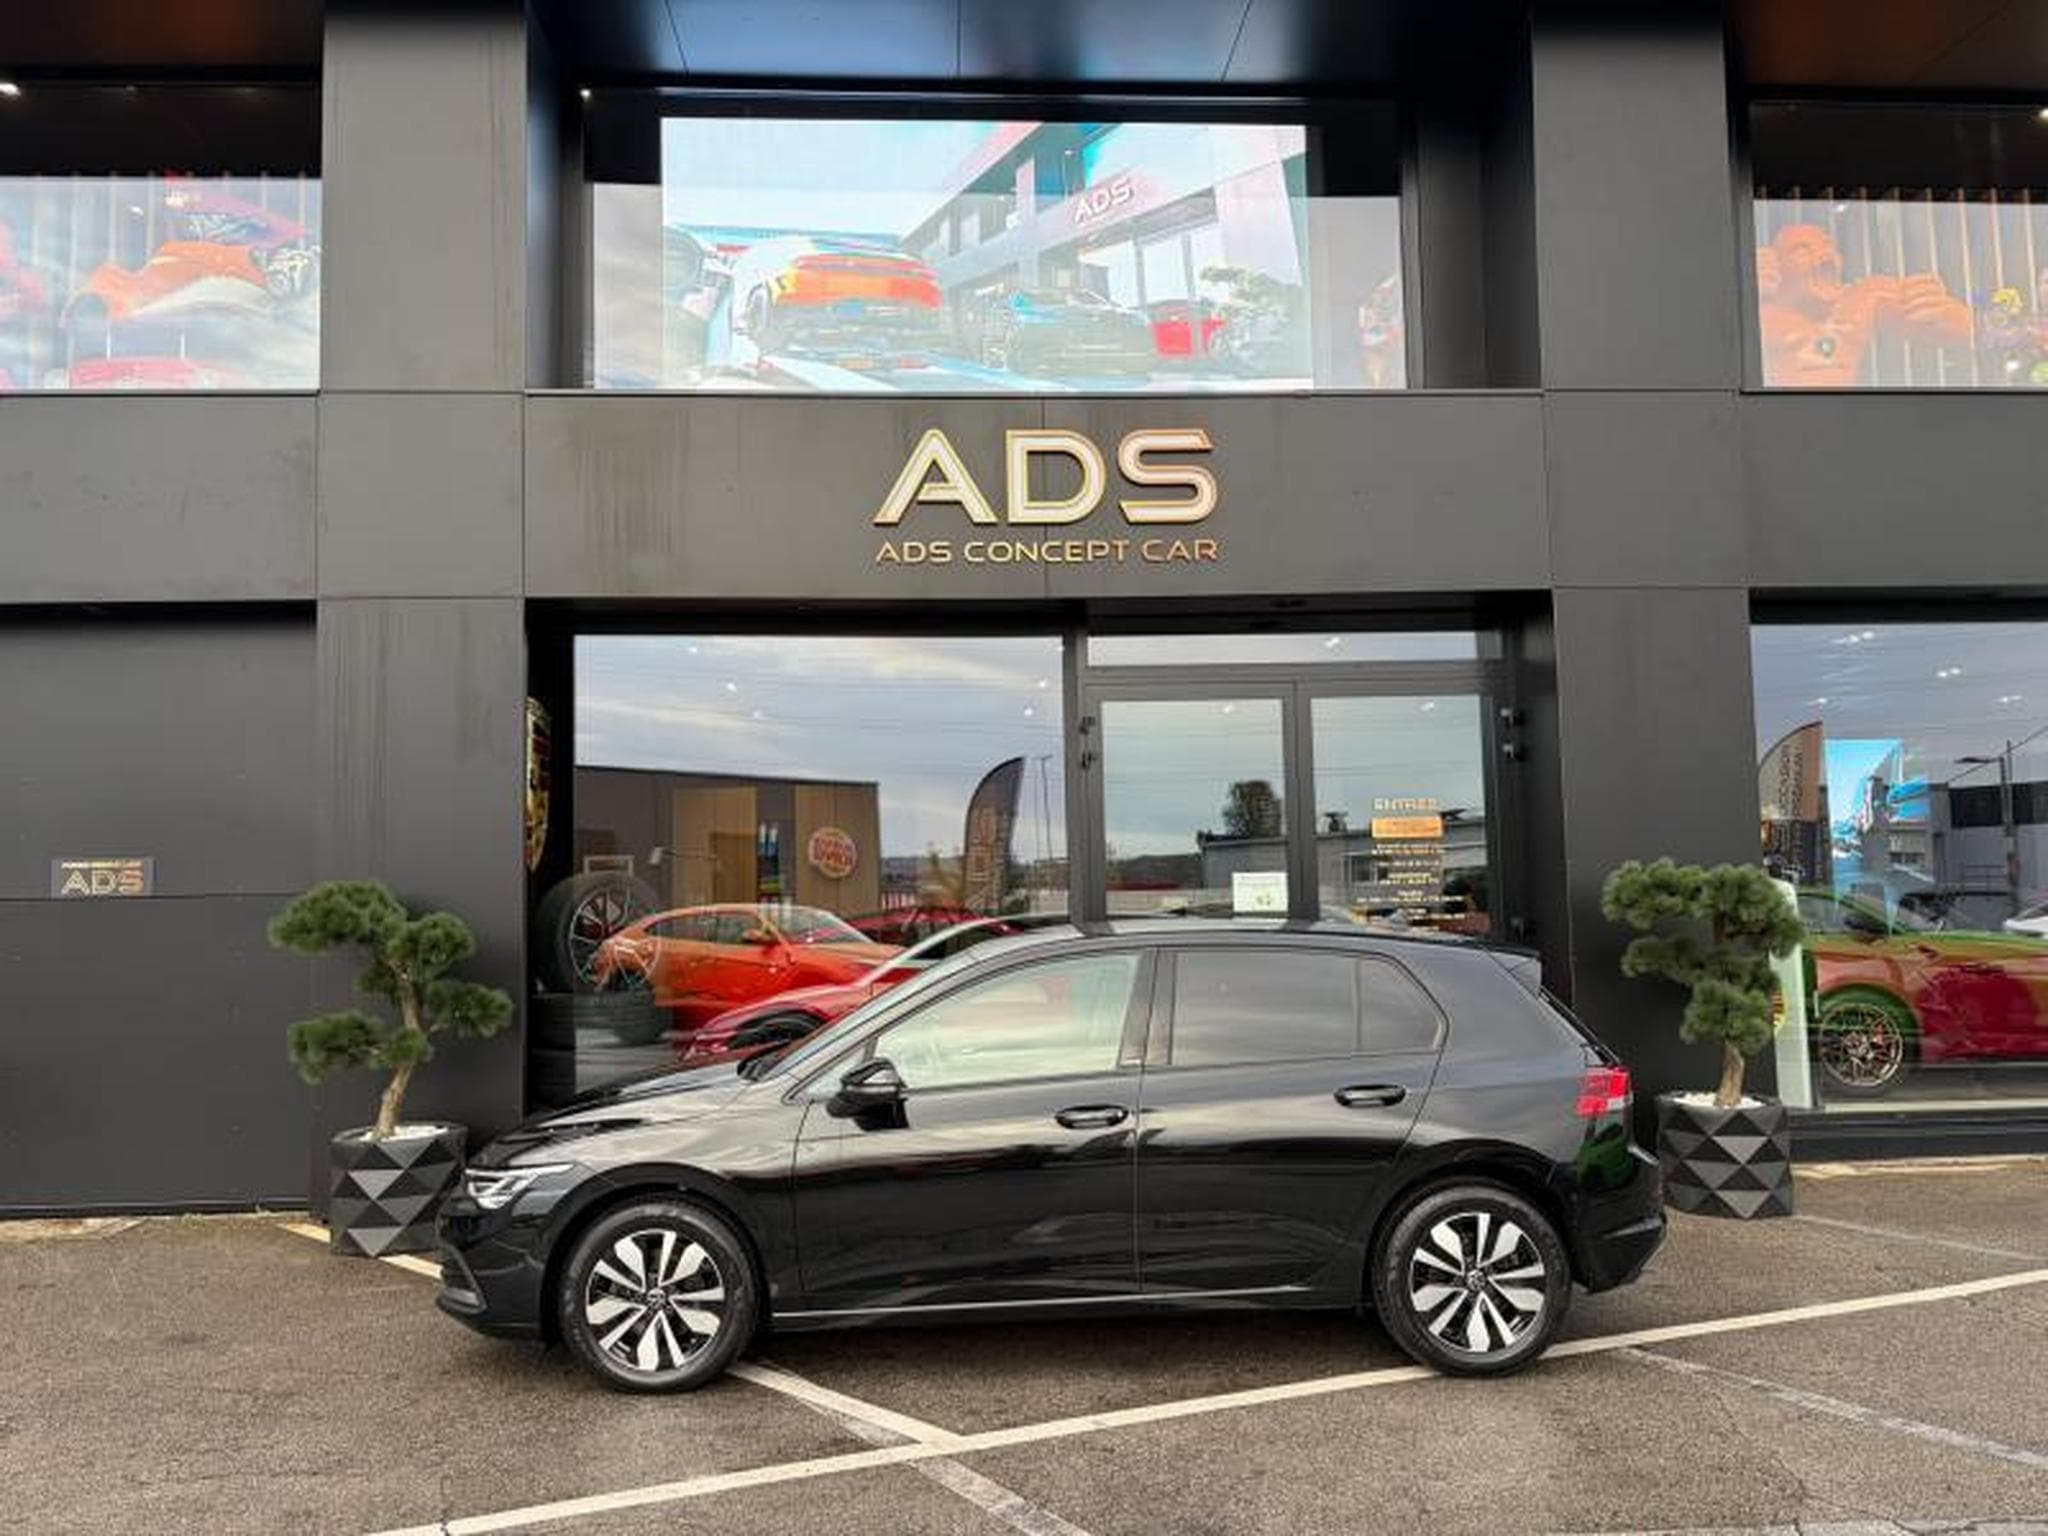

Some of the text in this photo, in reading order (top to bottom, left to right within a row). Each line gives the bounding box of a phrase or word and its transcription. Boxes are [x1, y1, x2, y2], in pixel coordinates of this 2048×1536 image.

[1073, 176, 1134, 223] ADS
[873, 428, 1218, 525] ADS
[875, 539, 1219, 564] ADS CONCEPT CAR
[61, 869, 145, 896] ADS
